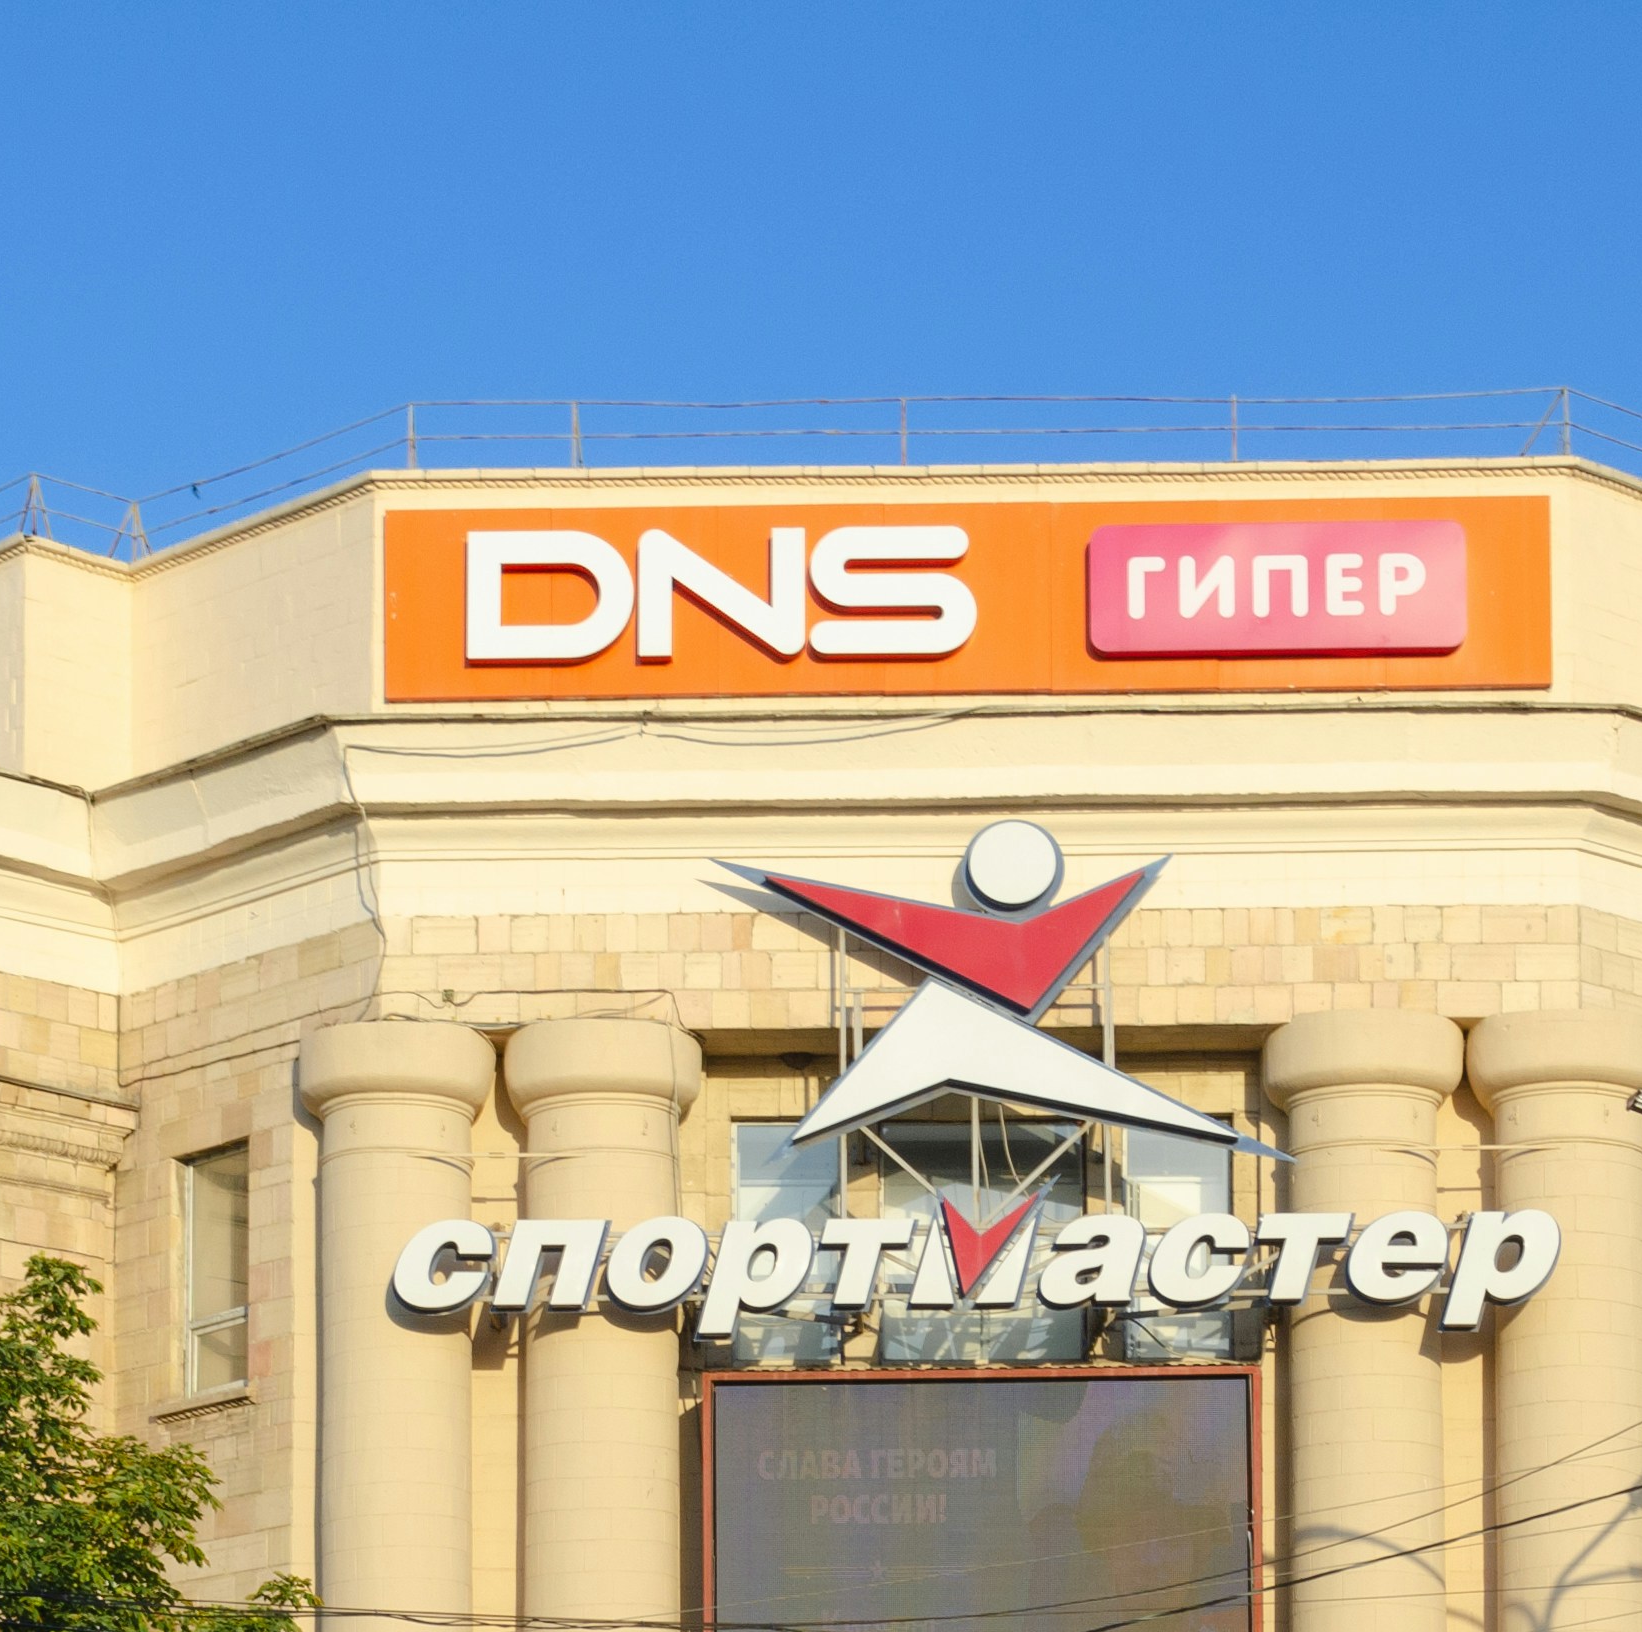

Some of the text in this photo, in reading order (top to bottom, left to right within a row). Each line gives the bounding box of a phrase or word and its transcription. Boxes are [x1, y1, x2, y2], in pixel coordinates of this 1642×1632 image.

[465, 524, 978, 665] DNS
[1127, 552, 1428, 619] ГИПЕР
[757, 1446, 997, 1481] СЛАВА ГЕРОЯМ
[810, 1494, 947, 1525] РОССИИ!
